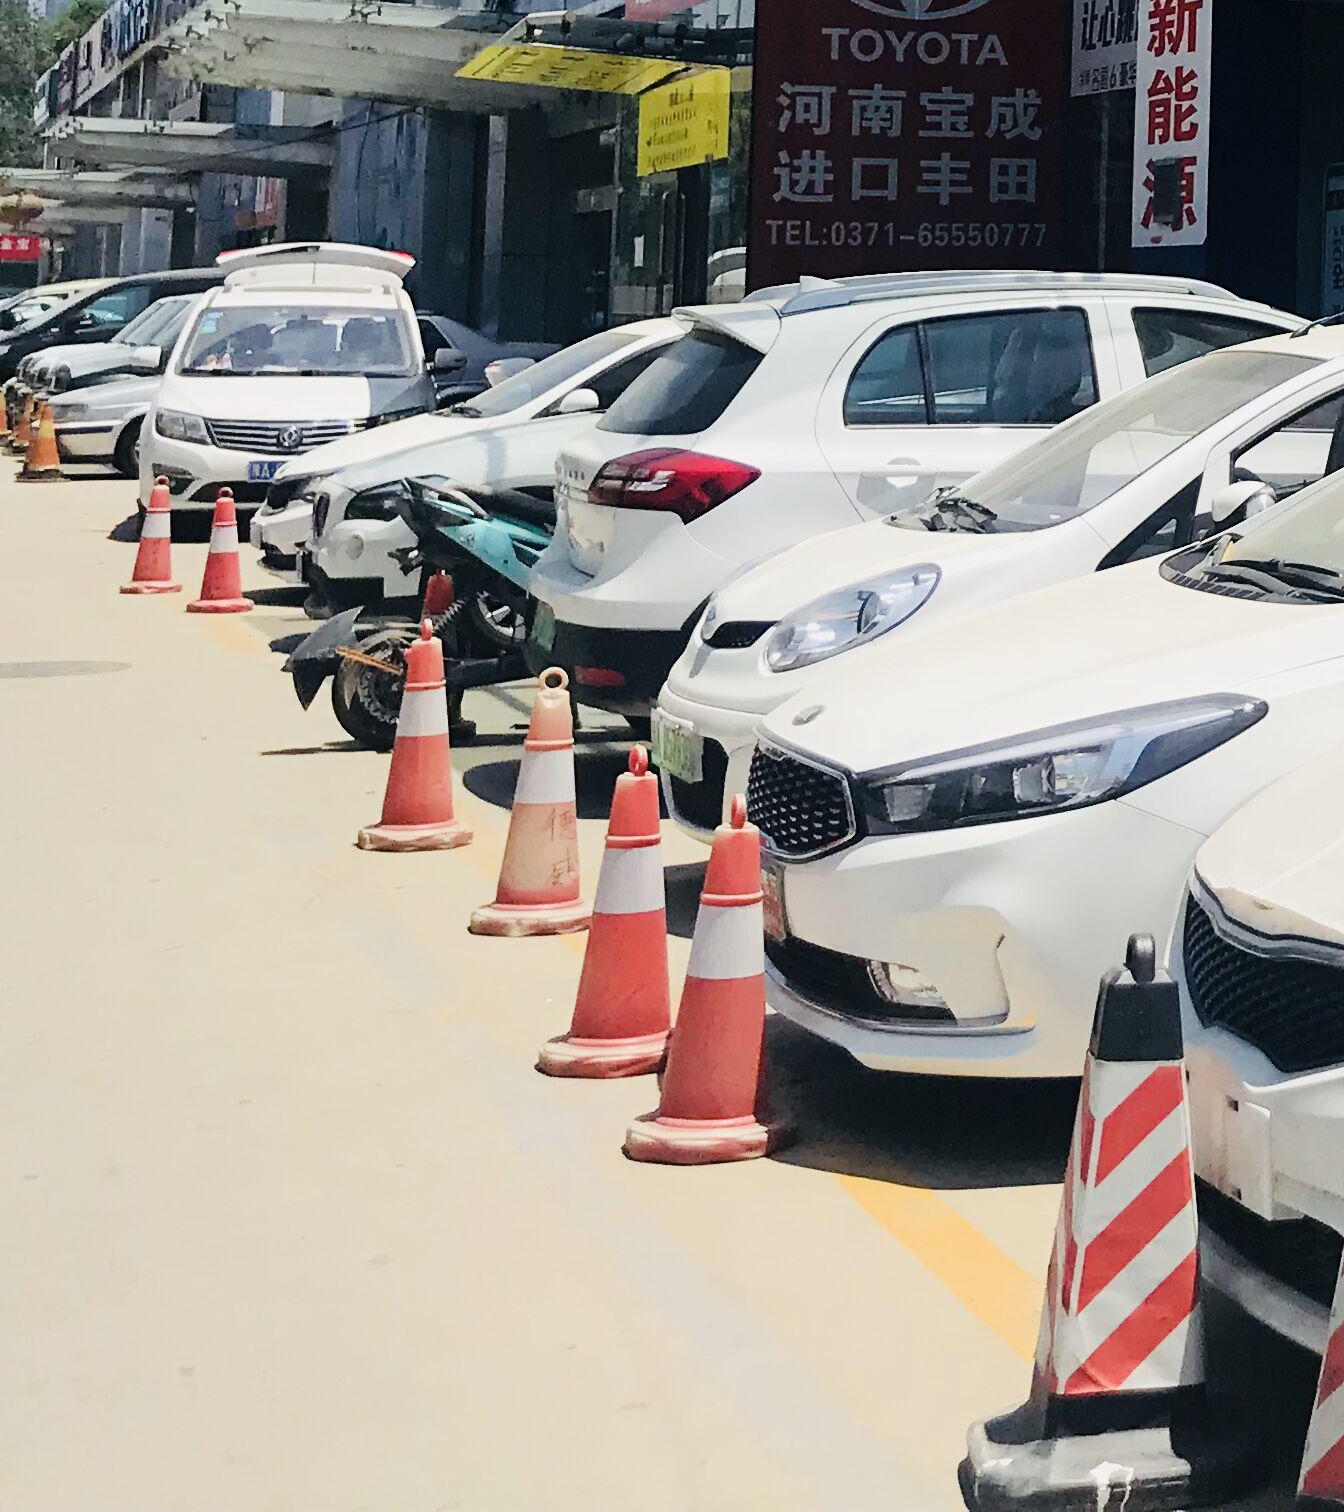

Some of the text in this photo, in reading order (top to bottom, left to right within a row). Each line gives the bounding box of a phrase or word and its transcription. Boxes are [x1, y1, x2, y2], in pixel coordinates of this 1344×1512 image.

[821, 27, 1009, 67] TOYOTA
[777, 81, 1043, 141] 河南宝成
[772, 149, 1038, 205] 进口丰田
[765, 219, 1048, 249] TEL:0371-65550777
